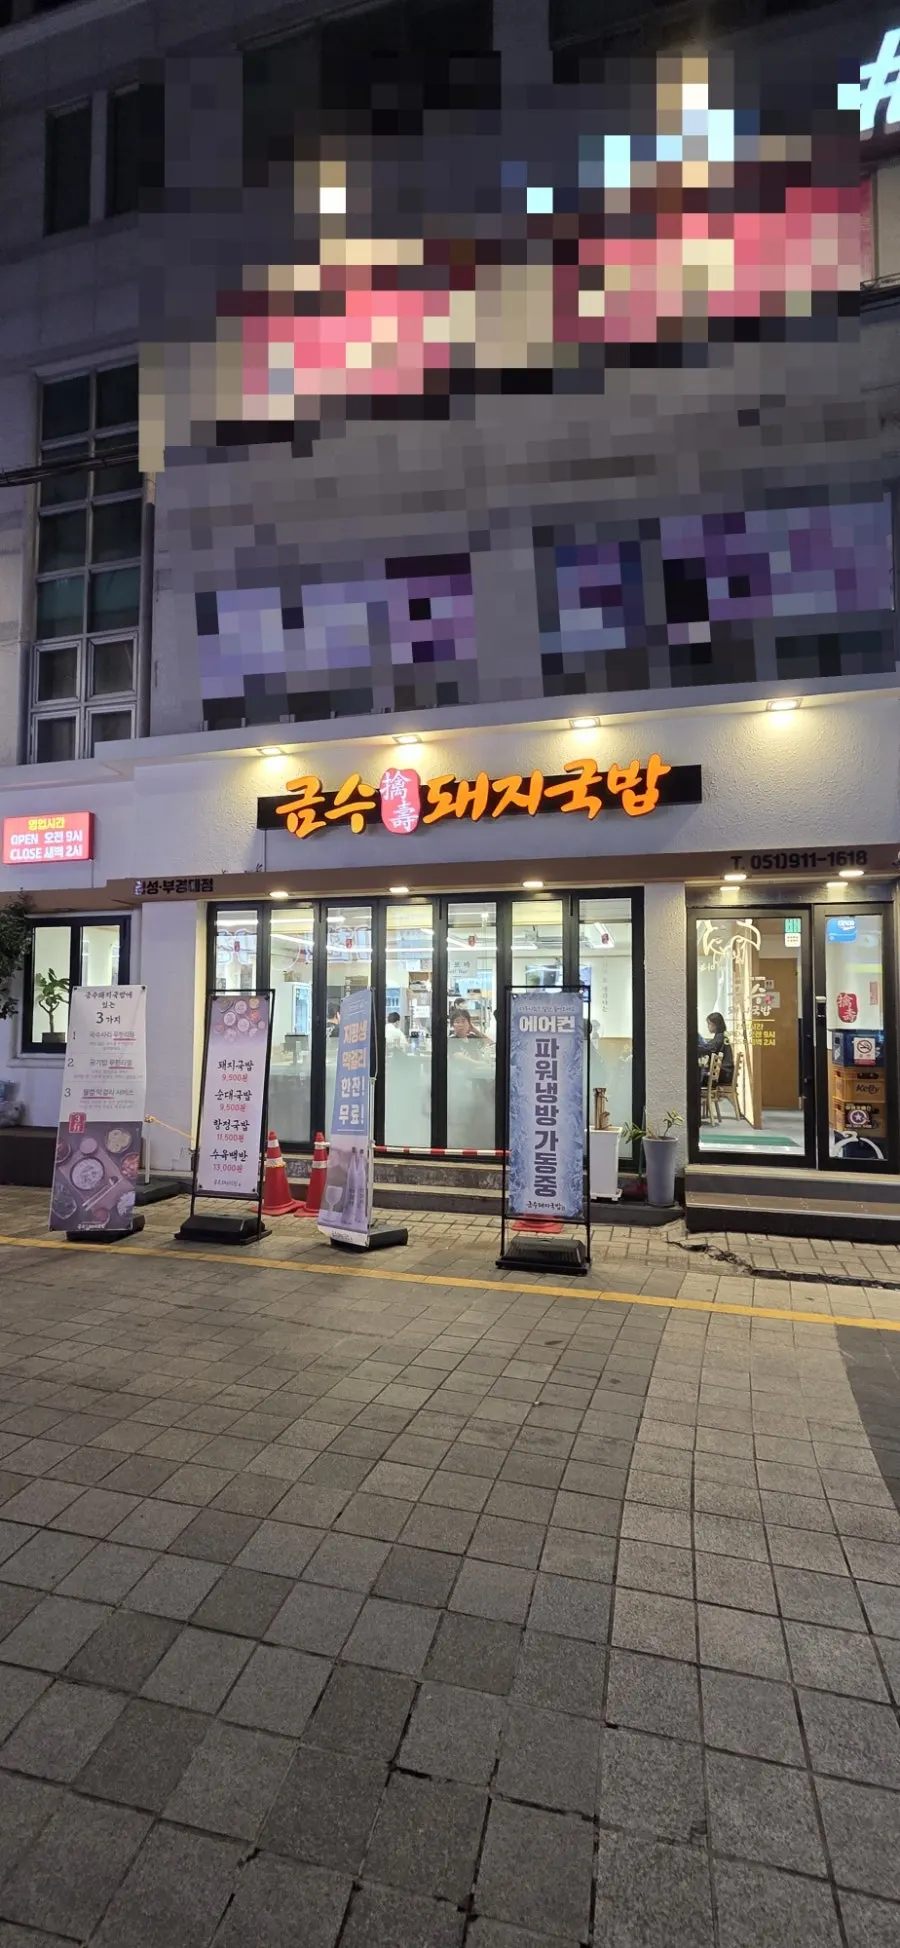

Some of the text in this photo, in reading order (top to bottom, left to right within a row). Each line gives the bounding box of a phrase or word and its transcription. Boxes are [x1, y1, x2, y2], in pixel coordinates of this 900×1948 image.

[422, 753, 671, 823] 돼지국밥
[275, 773, 376, 839] 금수
[28, 817, 65, 830] 영업시간
[11, 830, 82, 845] OPEN 오전 9시
[10, 845, 82, 860] CLOSE 새벽 2시
[730, 851, 868, 870] T. 051)911-1618
[519, 1015, 576, 1033] 에어컨
[764, 1038, 776, 1046] 2시
[67, 1058, 74, 1067] 2
[217, 1060, 254, 1071] 돼지국밥
[222, 1074, 248, 1082] 9,500원
[64, 1088, 71, 1097] 3
[341, 1076, 365, 1099] 한잔!
[856, 1083, 879, 1095] Kelly
[215, 1089, 252, 1101] 순대국밥
[220, 1104, 246, 1112] 9,500원
[339, 1103, 364, 1125] 무료!
[533, 1038, 559, 1197] 파워냉방 가동중
[213, 1119, 250, 1131] 항정국밥
[217, 1134, 244, 1142] 11,500원
[210, 1149, 248, 1161] 수육백반
[213, 1164, 243, 1173] 13,000원
